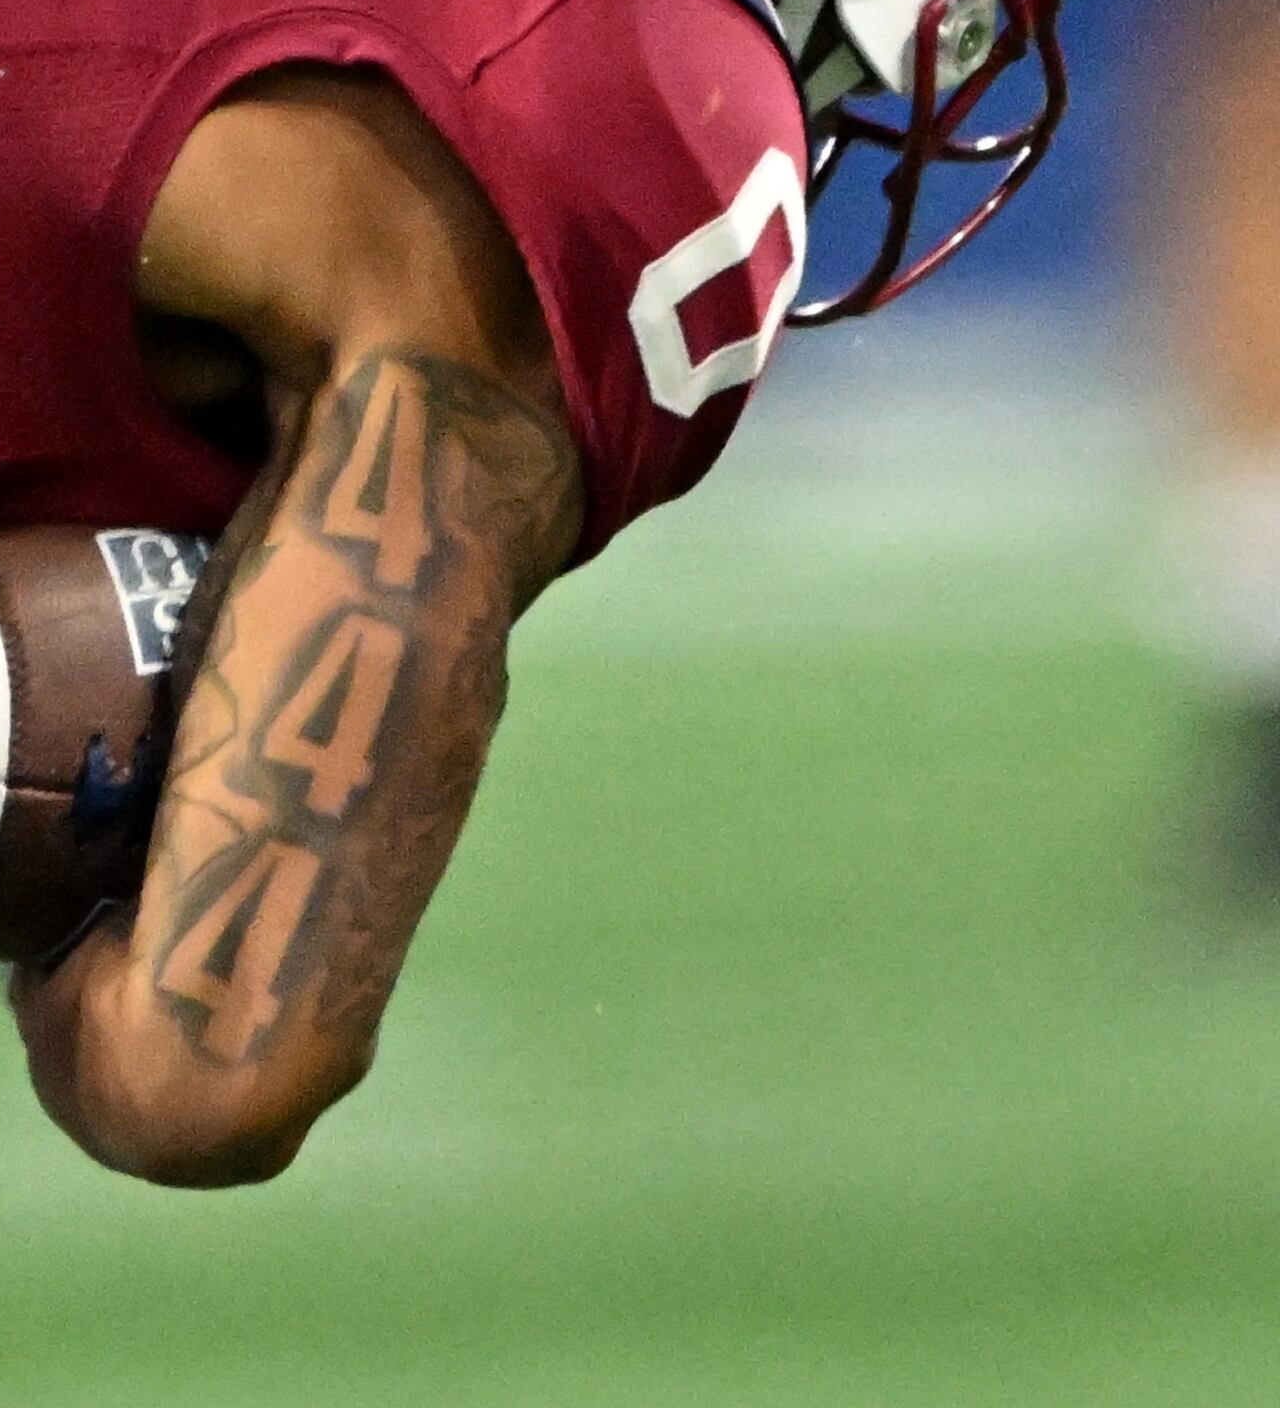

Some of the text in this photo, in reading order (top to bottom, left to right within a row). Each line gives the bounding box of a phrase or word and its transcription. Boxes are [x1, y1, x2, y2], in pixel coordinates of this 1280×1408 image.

[628, 147, 808, 419] 0
[322, 354, 432, 590] 4
[262, 610, 406, 818] 4
[156, 838, 322, 1068] 4
